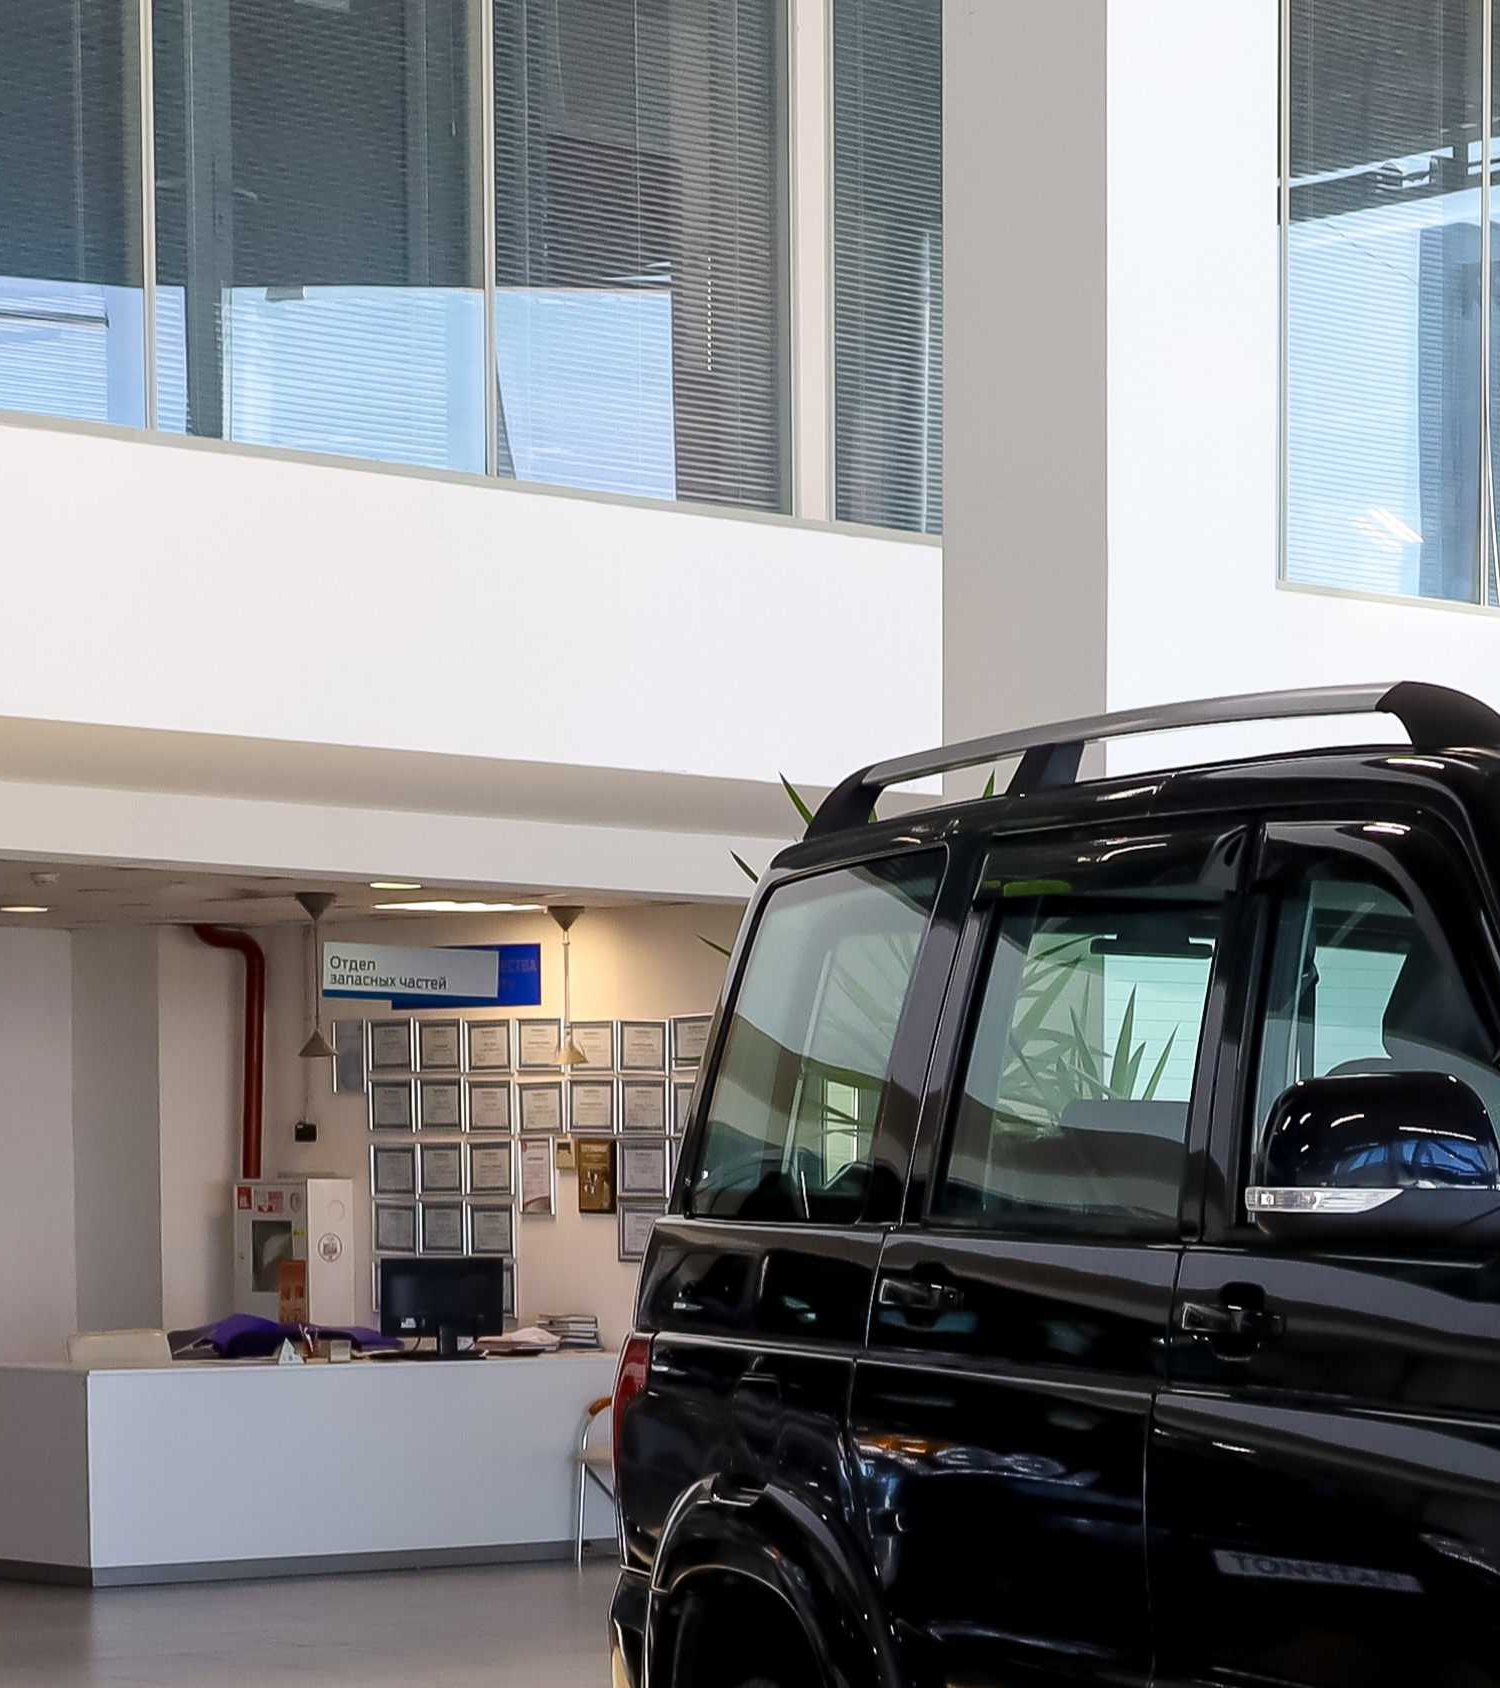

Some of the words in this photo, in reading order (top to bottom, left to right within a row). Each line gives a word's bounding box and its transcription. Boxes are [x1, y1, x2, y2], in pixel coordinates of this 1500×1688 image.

[329, 955, 376, 972] Отдел
[501, 959, 537, 973] ЕСТВА
[329, 973, 396, 988] запасных
[399, 975, 447, 990] частей
